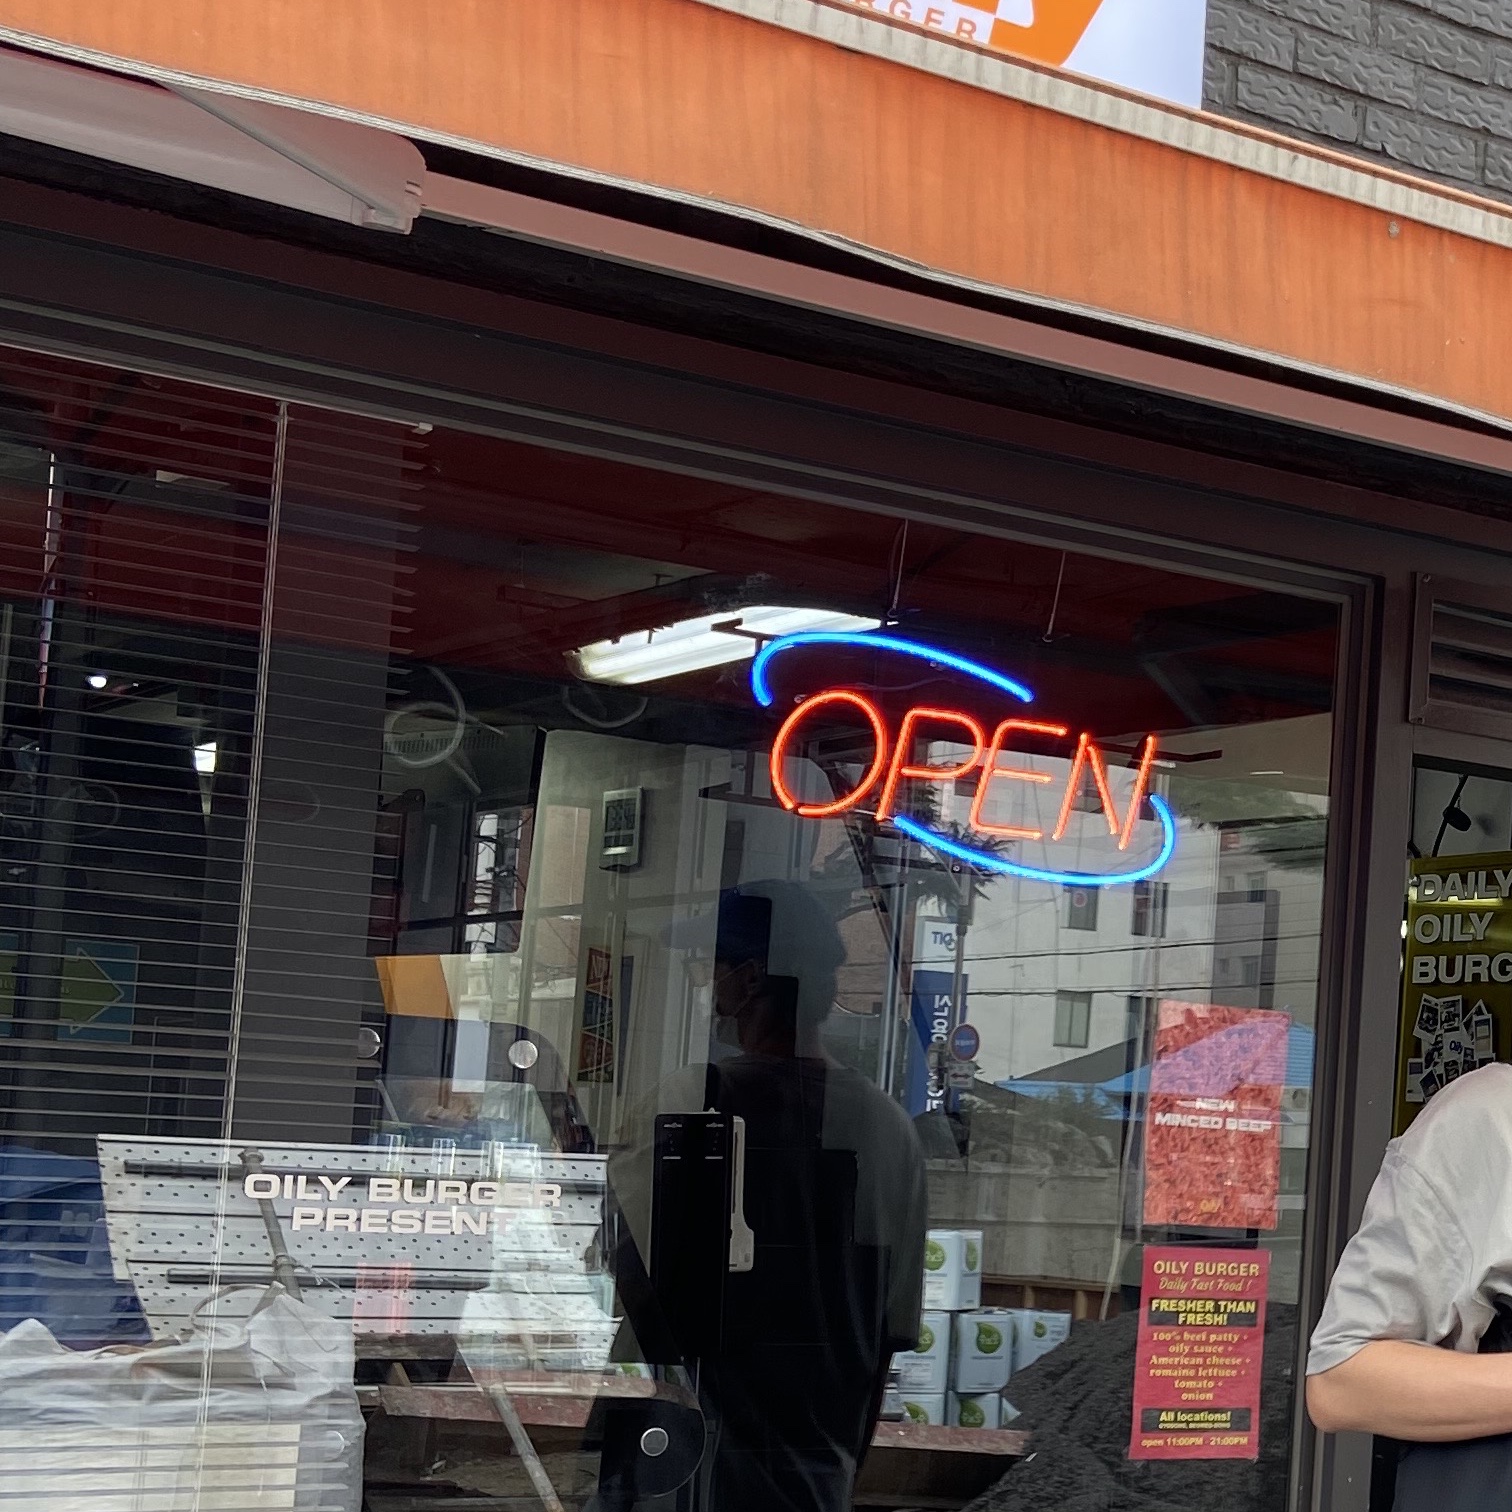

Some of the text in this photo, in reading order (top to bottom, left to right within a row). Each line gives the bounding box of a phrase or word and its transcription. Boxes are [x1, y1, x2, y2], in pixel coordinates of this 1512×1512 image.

[769, 688, 1159, 852] OPEN
[1414, 911, 1494, 944] OILY
[1195, 1097, 1235, 1112] NEW
[1155, 1112, 1272, 1132] MINCED BEEF
[244, 1173, 563, 1208] OILY BURGER
[291, 1206, 515, 1236] PRESENT
[1153, 1261, 1260, 1277] OILY BURGER
[1158, 1277, 1188, 1293] Daily
[1190, 1279, 1215, 1291] Fast
[1217, 1280, 1243, 1291] Food
[1151, 1299, 1256, 1313] FRESHER THAN
[1178, 1313, 1228, 1326] FRESH!
[1152, 1331, 1181, 1342] 100%
[1183, 1331, 1207, 1342] beef
[1209, 1332, 1240, 1344] patty
[1168, 1343, 1190, 1356] oily
[1193, 1345, 1224, 1354] sauce
[1149, 1355, 1203, 1365] American
[1206, 1356, 1243, 1365] cheese
[1149, 1368, 1196, 1377] romaine
[1198, 1367, 1237, 1378] lettuce
[1174, 1380, 1215, 1389] tomato
[1180, 1391, 1214, 1401] onion
[1159, 1410, 1232, 1422] All locations!
[1141, 1438, 1164, 1448] open
